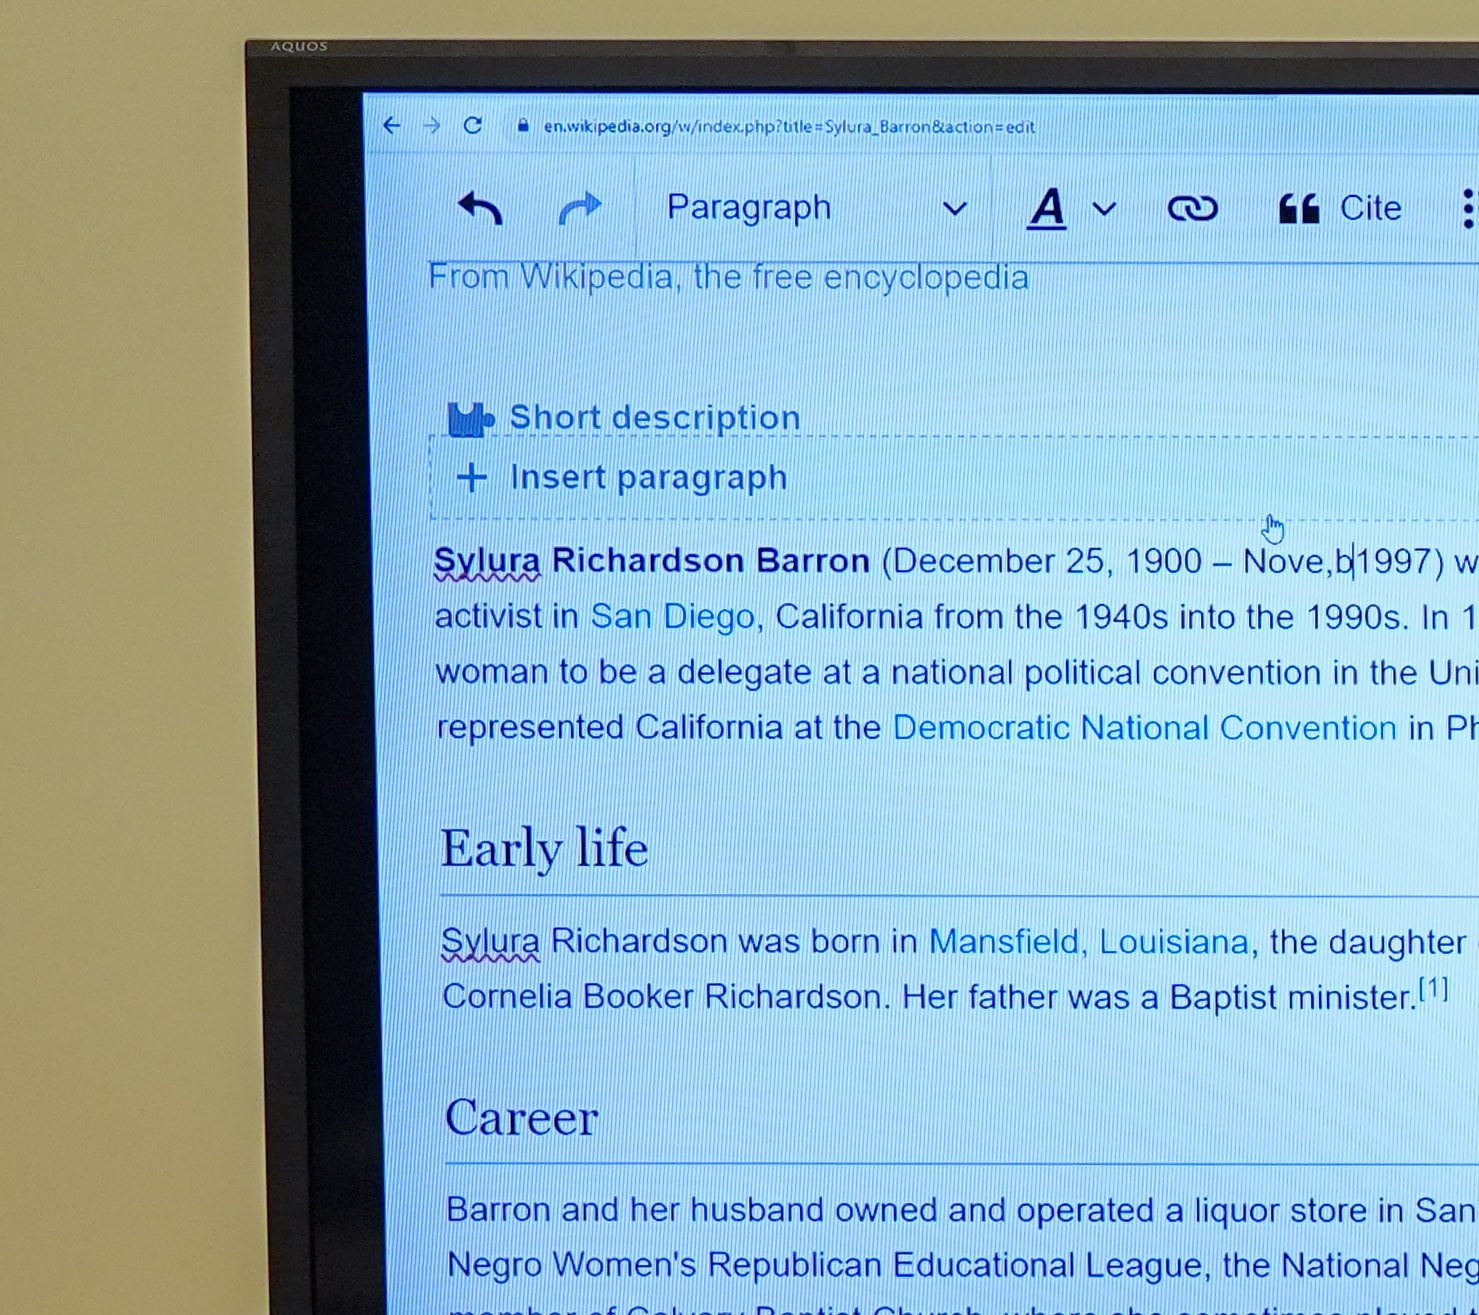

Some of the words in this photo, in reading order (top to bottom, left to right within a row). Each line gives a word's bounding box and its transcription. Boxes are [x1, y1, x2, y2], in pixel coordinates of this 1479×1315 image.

[270, 41, 328, 52] AQUOS
[668, 192, 831, 228] Paragraph
[1340, 193, 1402, 221] Cite
[427, 261, 509, 290] From
[520, 261, 683, 297] Wikipedia,
[694, 261, 743, 290] the
[752, 261, 813, 290] free
[824, 261, 1030, 299] encyclopedia
[510, 403, 603, 433] Short
[611, 403, 802, 440] description
[512, 463, 607, 490] Insert
[618, 463, 787, 497] paragraph
[433, 546, 542, 582] Sylura
[553, 546, 745, 573] Richardson
[757, 546, 870, 574] Barron
[882, 546, 1056, 582] (December
[1066, 546, 1113, 578] 25,
[1128, 547, 1202, 574] 1900
[435, 601, 543, 629] activist
[553, 601, 579, 629] in
[591, 601, 652, 629] San
[665, 601, 763, 636] Diego,
[776, 602, 923, 630] California
[934, 603, 1004, 630] from
[1015, 603, 1063, 631] the
[1076, 603, 1169, 630] 1940s
[1180, 603, 1236, 630] into
[1246, 603, 1294, 630] the
[1308, 603, 1409, 630] 1990s.
[1423, 603, 1449, 630] In
[438, 712, 624, 747] represented
[636, 713, 783, 740] California
[794, 714, 823, 740] at
[833, 713, 882, 740] the
[894, 713, 1070, 741] Democratic
[1082, 713, 1209, 741] National
[1220, 714, 1397, 742] Convention
[1409, 714, 1434, 741] in
[441, 824, 564, 878] Early
[576, 824, 648, 867] life
[440, 926, 540, 961] Sylura
[552, 927, 728, 954] Richardson
[738, 933, 801, 954] was
[811, 927, 880, 954] born
[892, 927, 917, 954] in
[930, 927, 1087, 958] Mansfield,
[1101, 928, 1258, 959] Louisiana,
[1270, 927, 1318, 955] the
[1329, 928, 1467, 964] daughter
[442, 982, 573, 1010] Cornelia
[584, 981, 695, 1009] Booker
[706, 982, 890, 1010] Richardson.
[903, 983, 959, 1011] Her
[968, 982, 1059, 1010] father
[1067, 989, 1131, 1010] was
[1140, 989, 1159, 1011] a
[1171, 983, 1278, 1018] Baptist
[445, 1097, 600, 1136] Career
[447, 1195, 551, 1222] Barron
[561, 1195, 619, 1222] and
[631, 1196, 681, 1223] her
[691, 1196, 824, 1223] husband
[835, 1195, 938, 1223] owned
[948, 1195, 1006, 1223] and
[1017, 1196, 1154, 1231] operated
[1165, 1202, 1184, 1223] a
[1195, 1196, 1281, 1231] liquor
[1291, 1197, 1367, 1223] store
[1379, 1196, 1404, 1223] in
[1416, 1196, 1476, 1224] San
